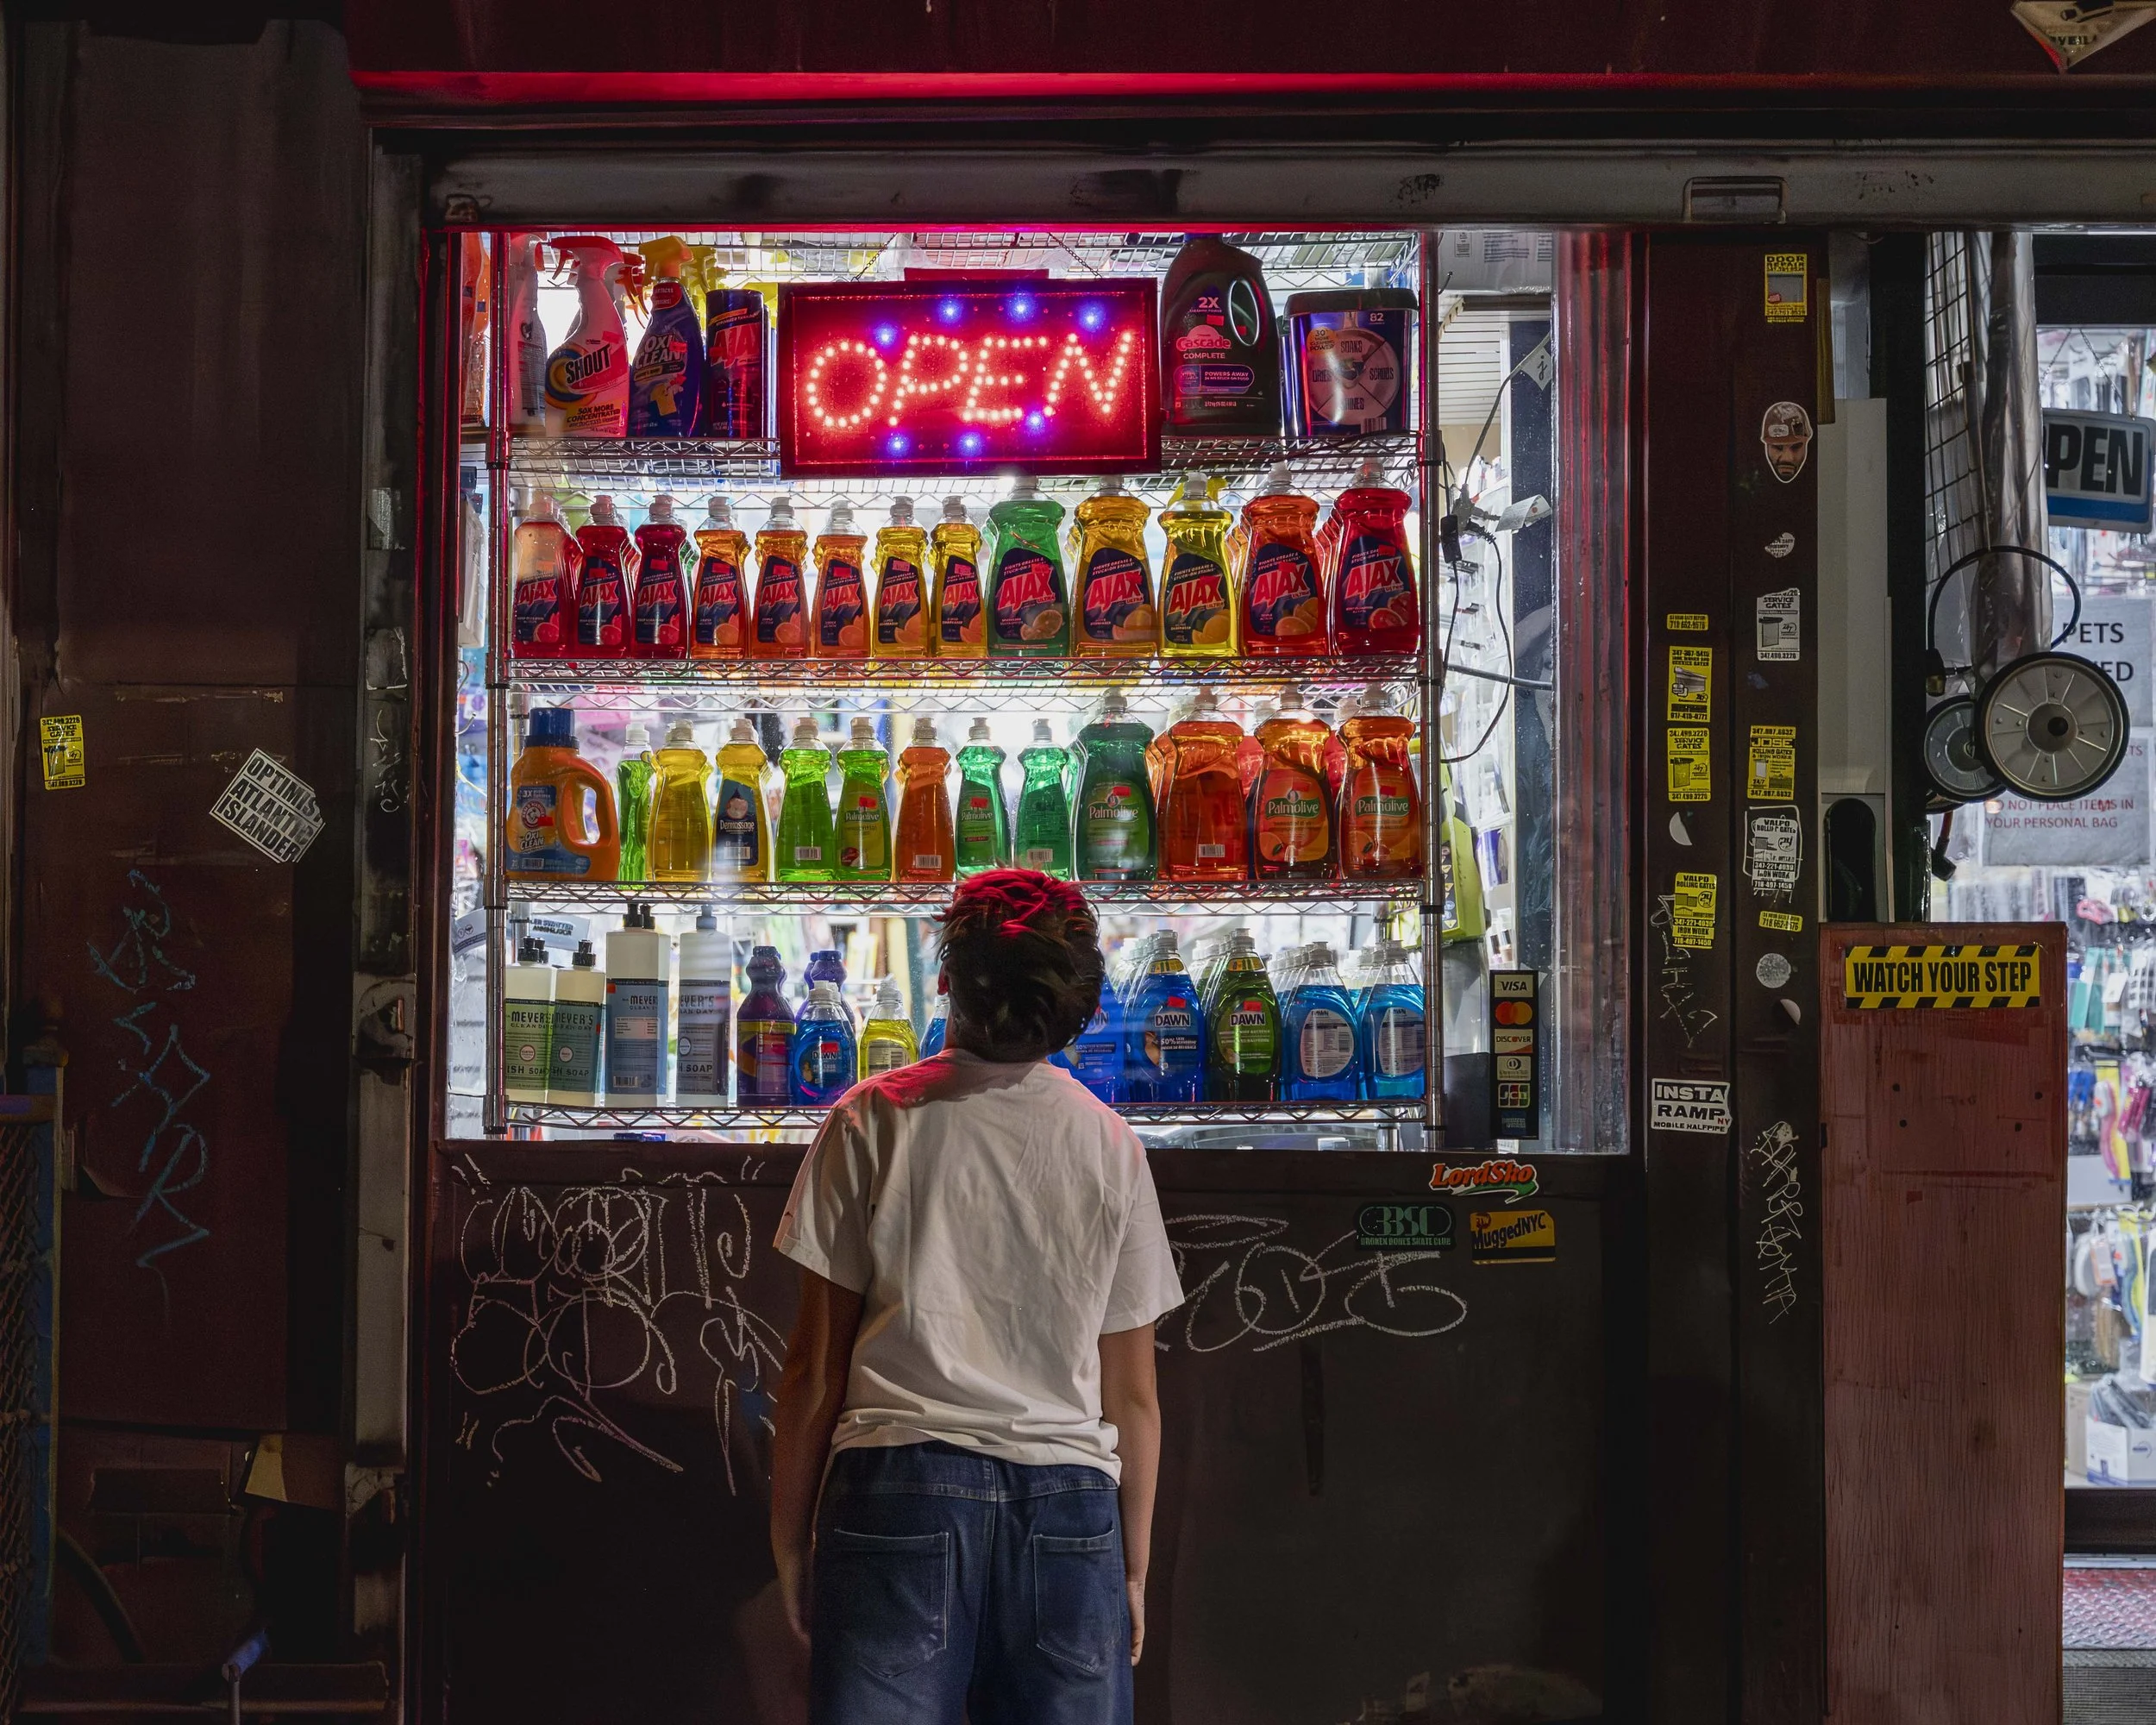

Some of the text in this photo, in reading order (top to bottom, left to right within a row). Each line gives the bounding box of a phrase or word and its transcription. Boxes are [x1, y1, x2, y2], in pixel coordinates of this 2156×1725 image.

[1198, 297, 1219, 308] 2X
[1369, 312, 1384, 322] 82
[647, 335, 674, 354] OXI
[1176, 335, 1232, 351] Cascade
[565, 344, 611, 385] SHOUT
[636, 348, 681, 370] CLEAN
[805, 331, 1133, 428] OPEN
[567, 409, 621, 423] CONCENTRATED
[2043, 423, 2144, 497] PEN
[1253, 562, 1310, 608] AJAX
[1345, 556, 1404, 600] AJAX
[519, 579, 557, 606] AJAX
[580, 580, 619, 608] AJAX
[638, 580, 677, 608] AJAX
[699, 580, 737, 608] AJAX
[760, 580, 798, 608] AJAX
[822, 583, 862, 612] AJAX
[881, 580, 918, 610] AJAX
[942, 580, 978, 607] AJAX
[998, 567, 1055, 612] AJAX
[1037, 593, 1056, 604] ULTRA
[1086, 570, 1142, 612] AJAX
[1167, 574, 1224, 616] AJAX
[2063, 622, 2125, 644] PETS
[1752, 738, 1795, 747] JOSE
[1089, 805, 1139, 819] Palmolive
[1268, 800, 1319, 814] Palmolive
[1358, 800, 1409, 812] Palmolive
[2009, 800, 2038, 810] NOT
[2043, 800, 2076, 811] PLACE
[2079, 799, 2118, 812] ITEMS
[2121, 799, 2134, 810] IN
[719, 819, 755, 831] Dermassage
[845, 811, 880, 822] Palmolive
[962, 811, 993, 821] Palmolive
[1986, 817, 2119, 829] YOUR PERSONAL BAG
[216, 795, 301, 862] ISLANDER
[524, 830, 539, 840] OXI
[520, 837, 544, 850] CLEAN
[1501, 981, 1527, 991] VISA
[1852, 961, 2032, 993] WATCH YOUR STEP
[1155, 1014, 1190, 1027] DAWN
[1231, 1013, 1266, 1026] DAWN
[507, 1065, 524, 1074] ISH
[686, 1064, 712, 1073] SOAP
[1656, 1084, 1725, 1102] INSTA
[1658, 1104, 1726, 1120] RAMP
[1686, 1123, 1726, 1132] HALFPIPE
[1431, 1160, 1535, 1189] LordSho
[1471, 1212, 1547, 1250] MuggedNYC
